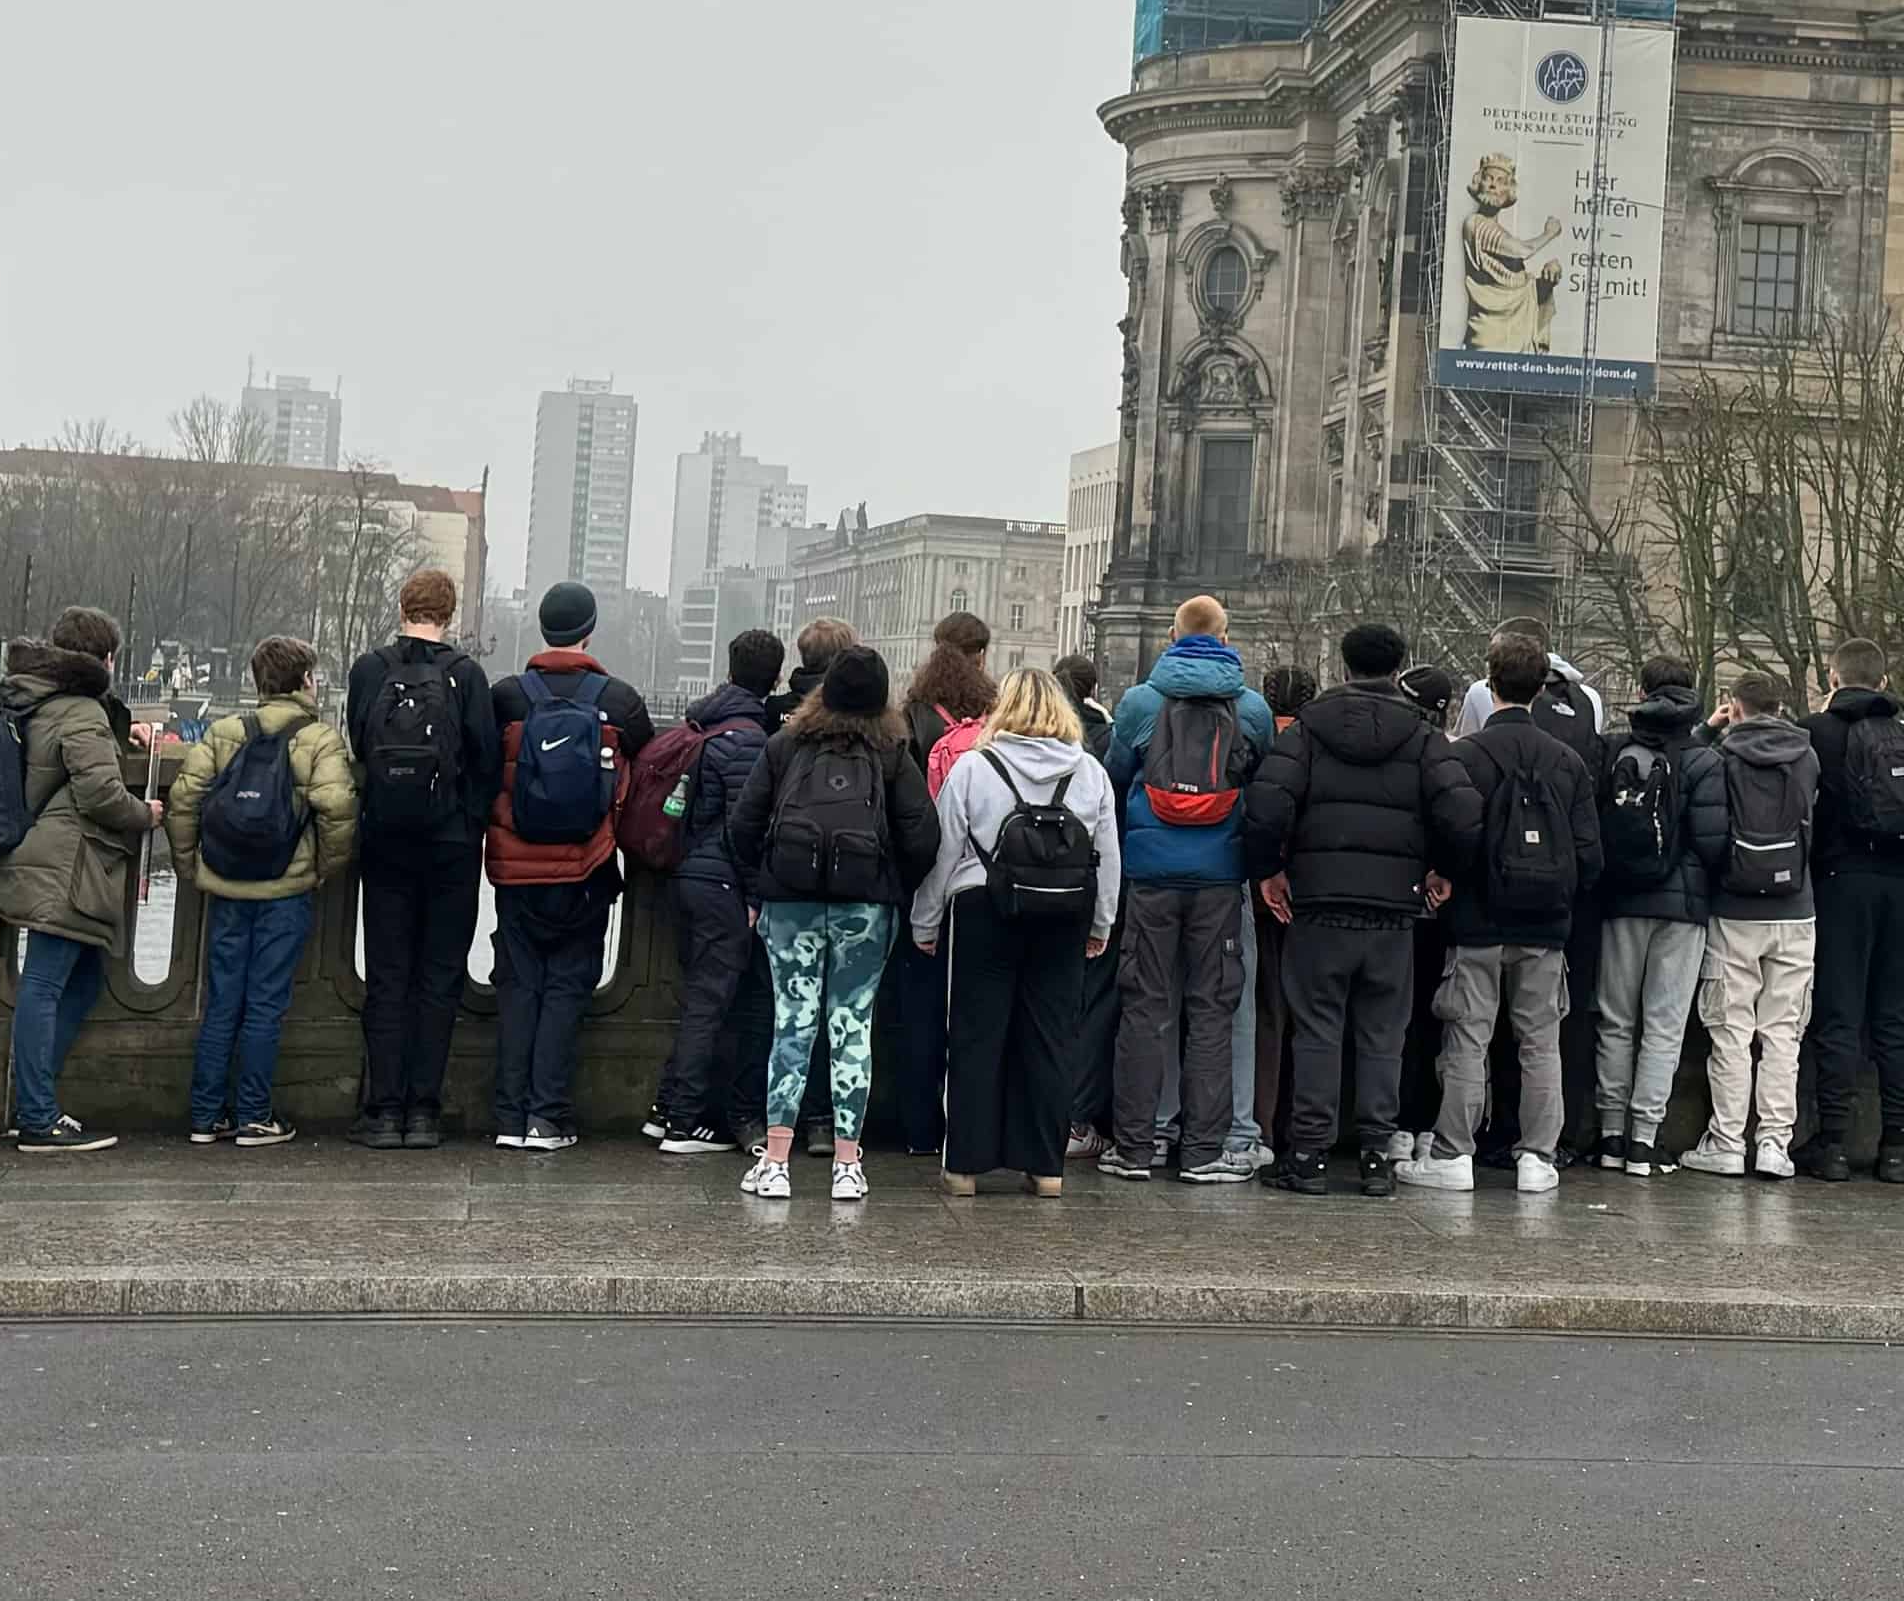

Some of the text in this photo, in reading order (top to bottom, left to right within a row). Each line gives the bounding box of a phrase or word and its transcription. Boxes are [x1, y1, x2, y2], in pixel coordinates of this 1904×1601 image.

[1482, 107, 1637, 128] DEUTSCHE STIFUNG
[1575, 170, 1619, 191] Her
[1572, 222, 1605, 240] wr
[1570, 252, 1633, 270] reten
[1606, 277, 1647, 297] mit!
[1456, 358, 1638, 381] www.rettet-den-berlinerdom.de
